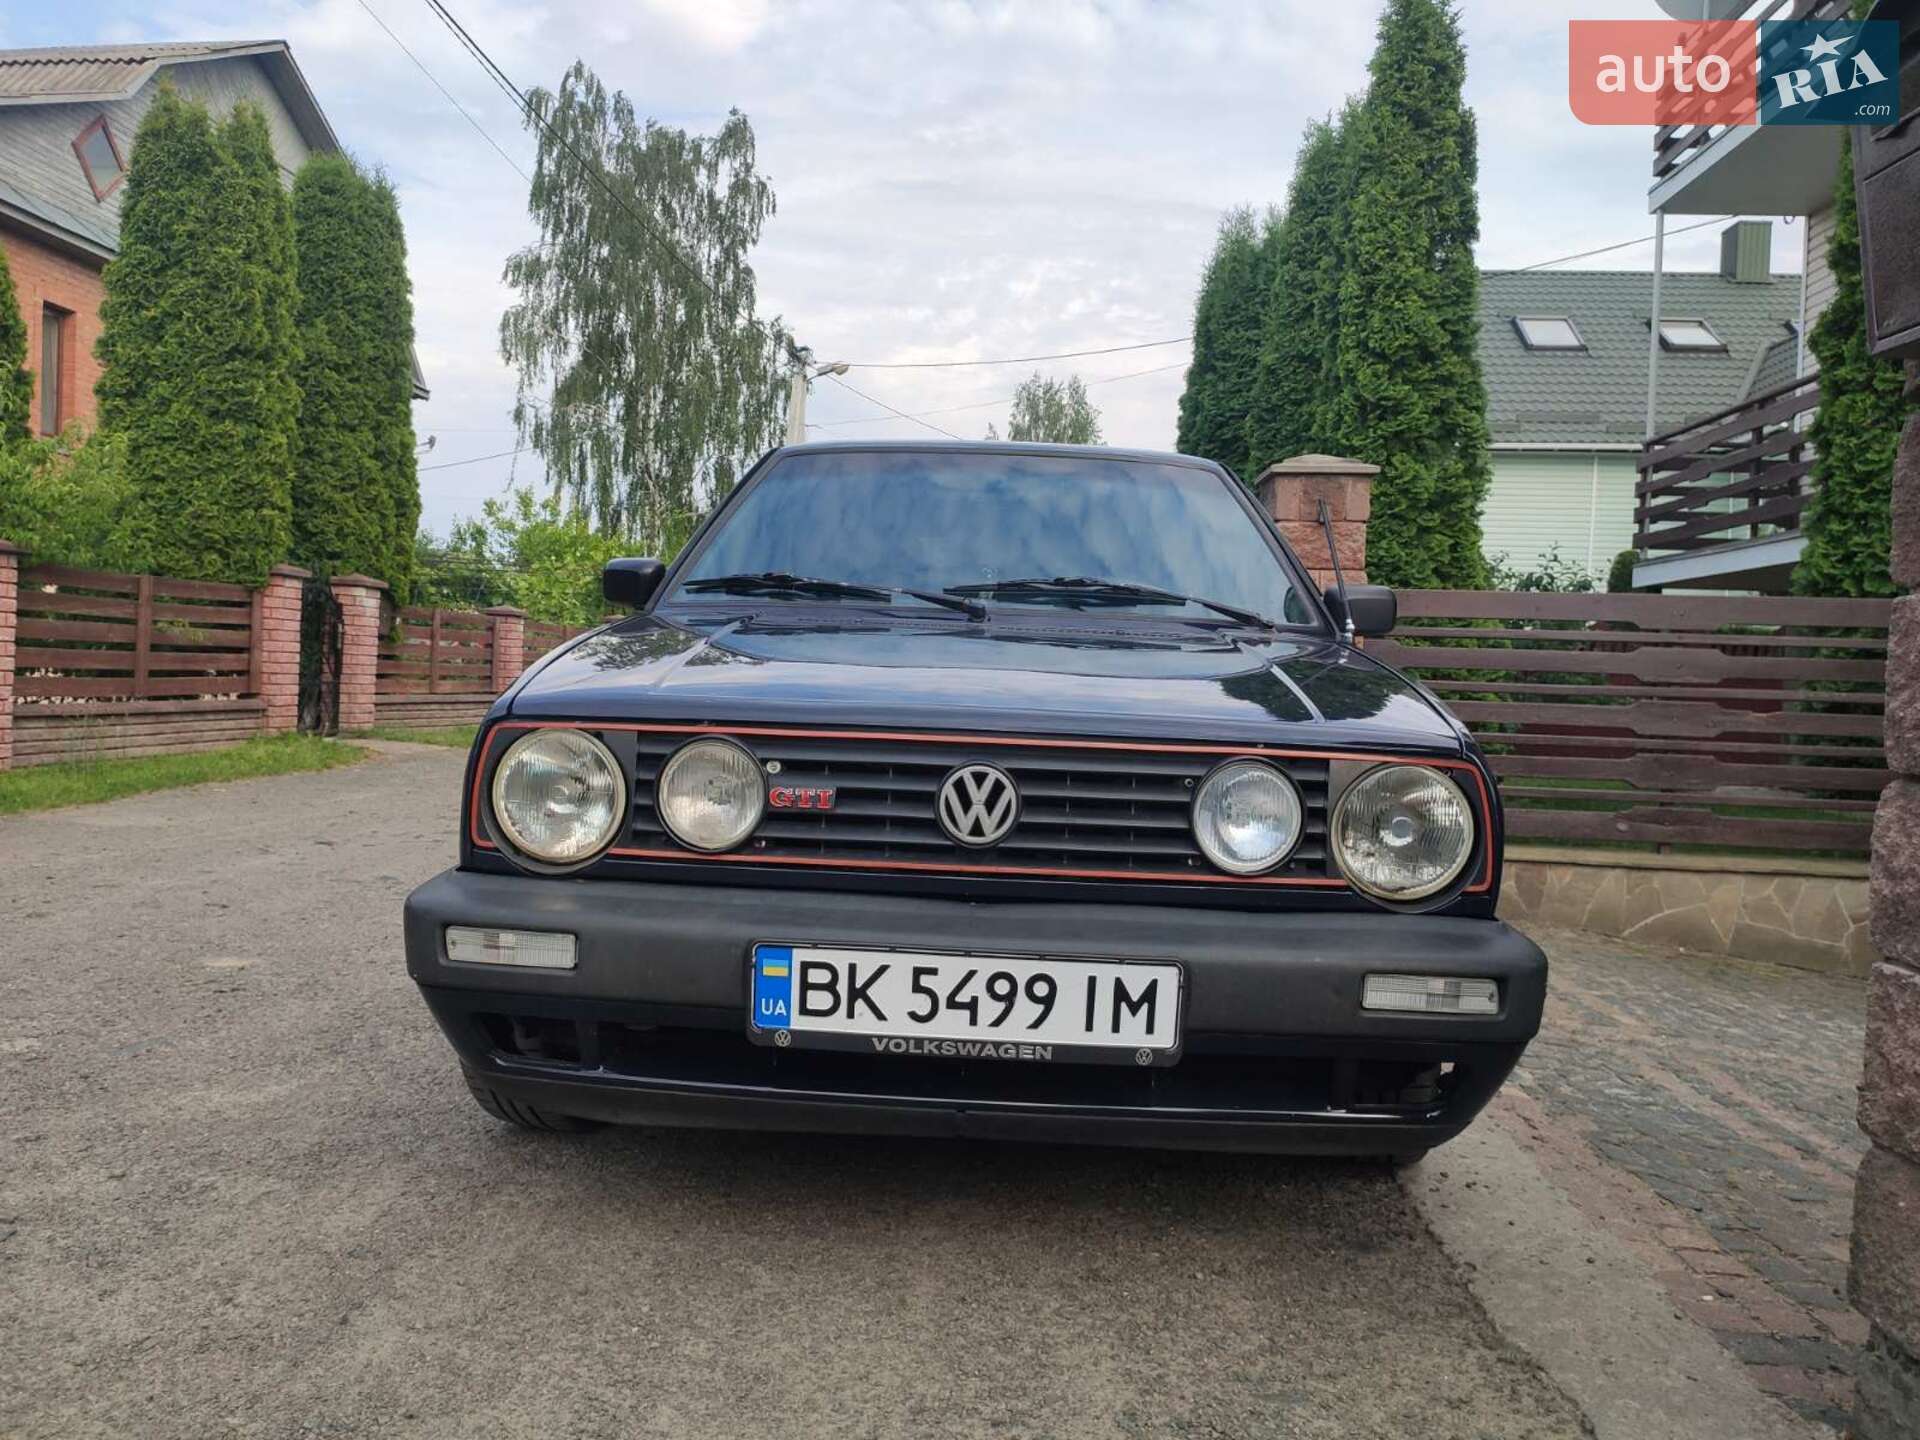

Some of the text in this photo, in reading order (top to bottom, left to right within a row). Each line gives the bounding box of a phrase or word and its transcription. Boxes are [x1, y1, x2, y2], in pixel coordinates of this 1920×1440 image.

[769, 786, 834, 809] GTI
[761, 998, 787, 1017] UA
[798, 960, 1159, 1035] BK 5499 IM
[872, 1036, 1053, 1061] VOLKSWAGEN
